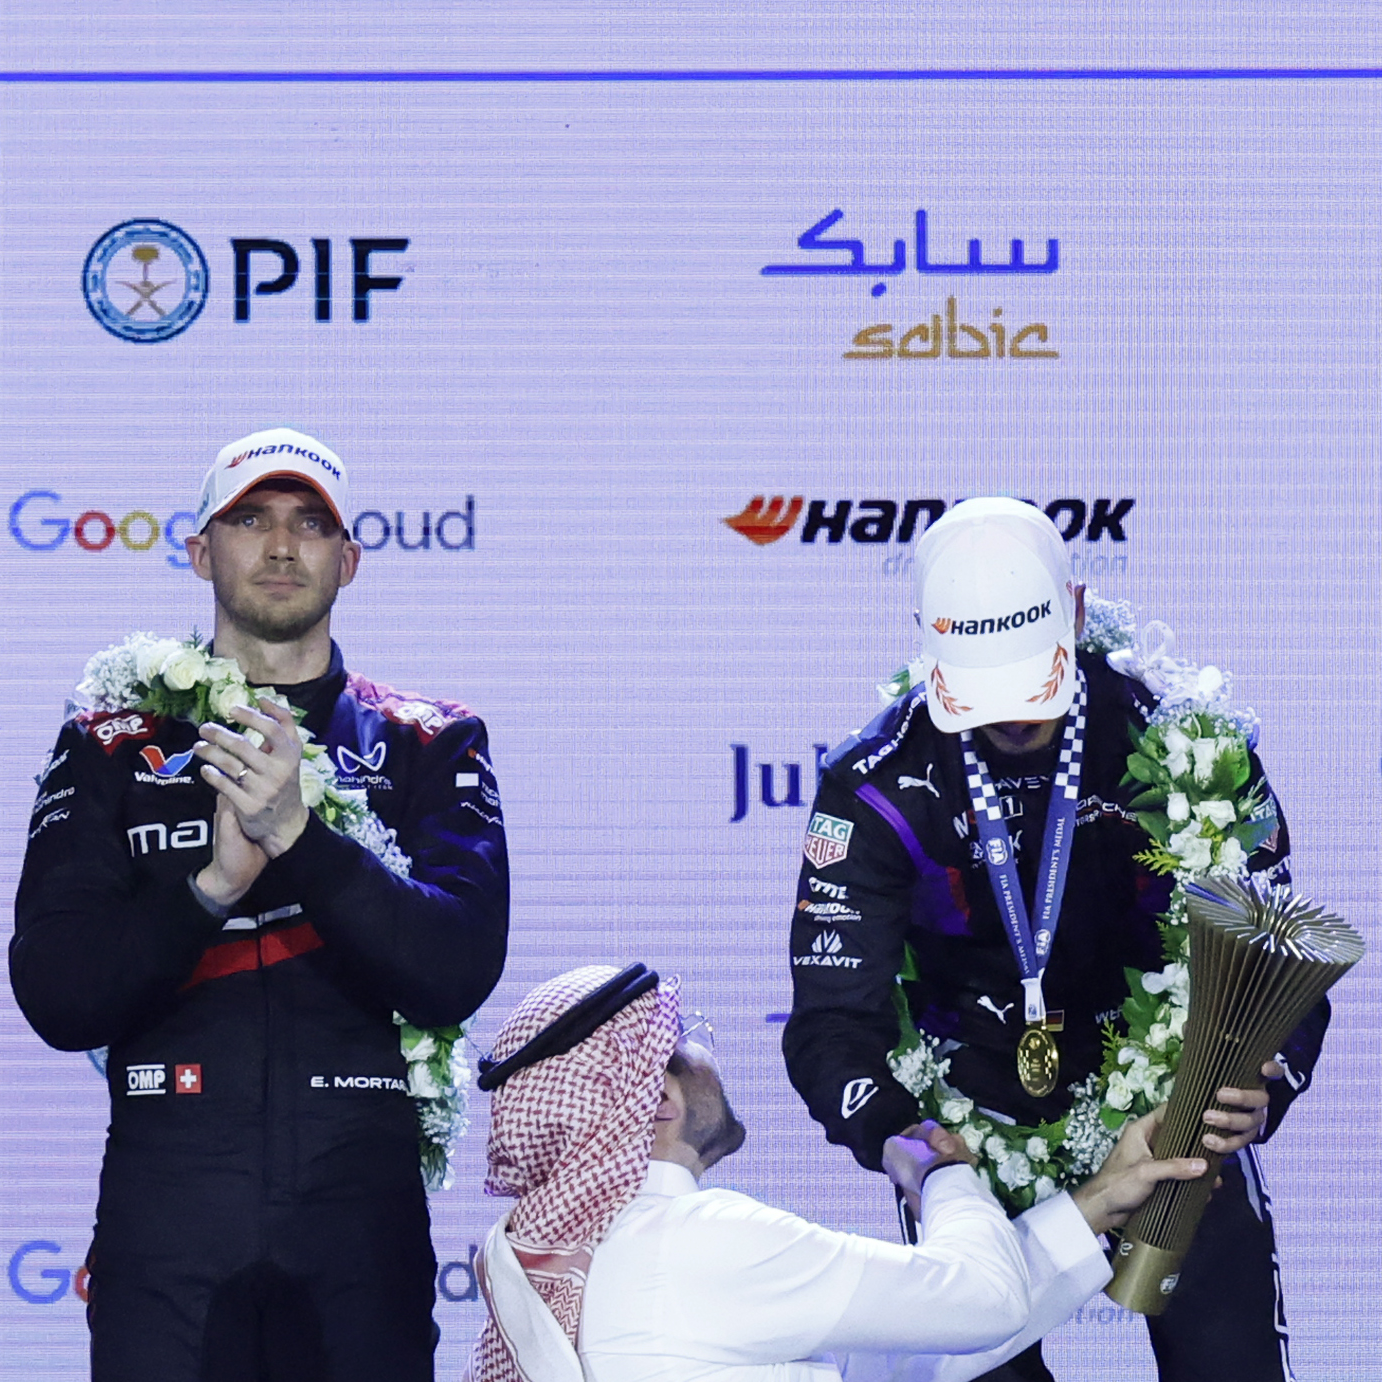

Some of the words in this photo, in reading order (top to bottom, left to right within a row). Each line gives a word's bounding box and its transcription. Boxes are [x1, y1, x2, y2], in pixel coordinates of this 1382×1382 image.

[759, 208, 1059, 297] سابك
[230, 238, 411, 323] PIF
[8, 490, 198, 568] Goog
[352, 494, 476, 553] oud
[800, 498, 1137, 542] HANOK
[94, 714, 146, 743] OMP
[812, 816, 848, 841] TAG
[793, 955, 863, 969] VEXAVIT
[127, 1069, 166, 1090] OMP
[310, 1076, 329, 1088] E.
[334, 1076, 409, 1092] MORTAR
